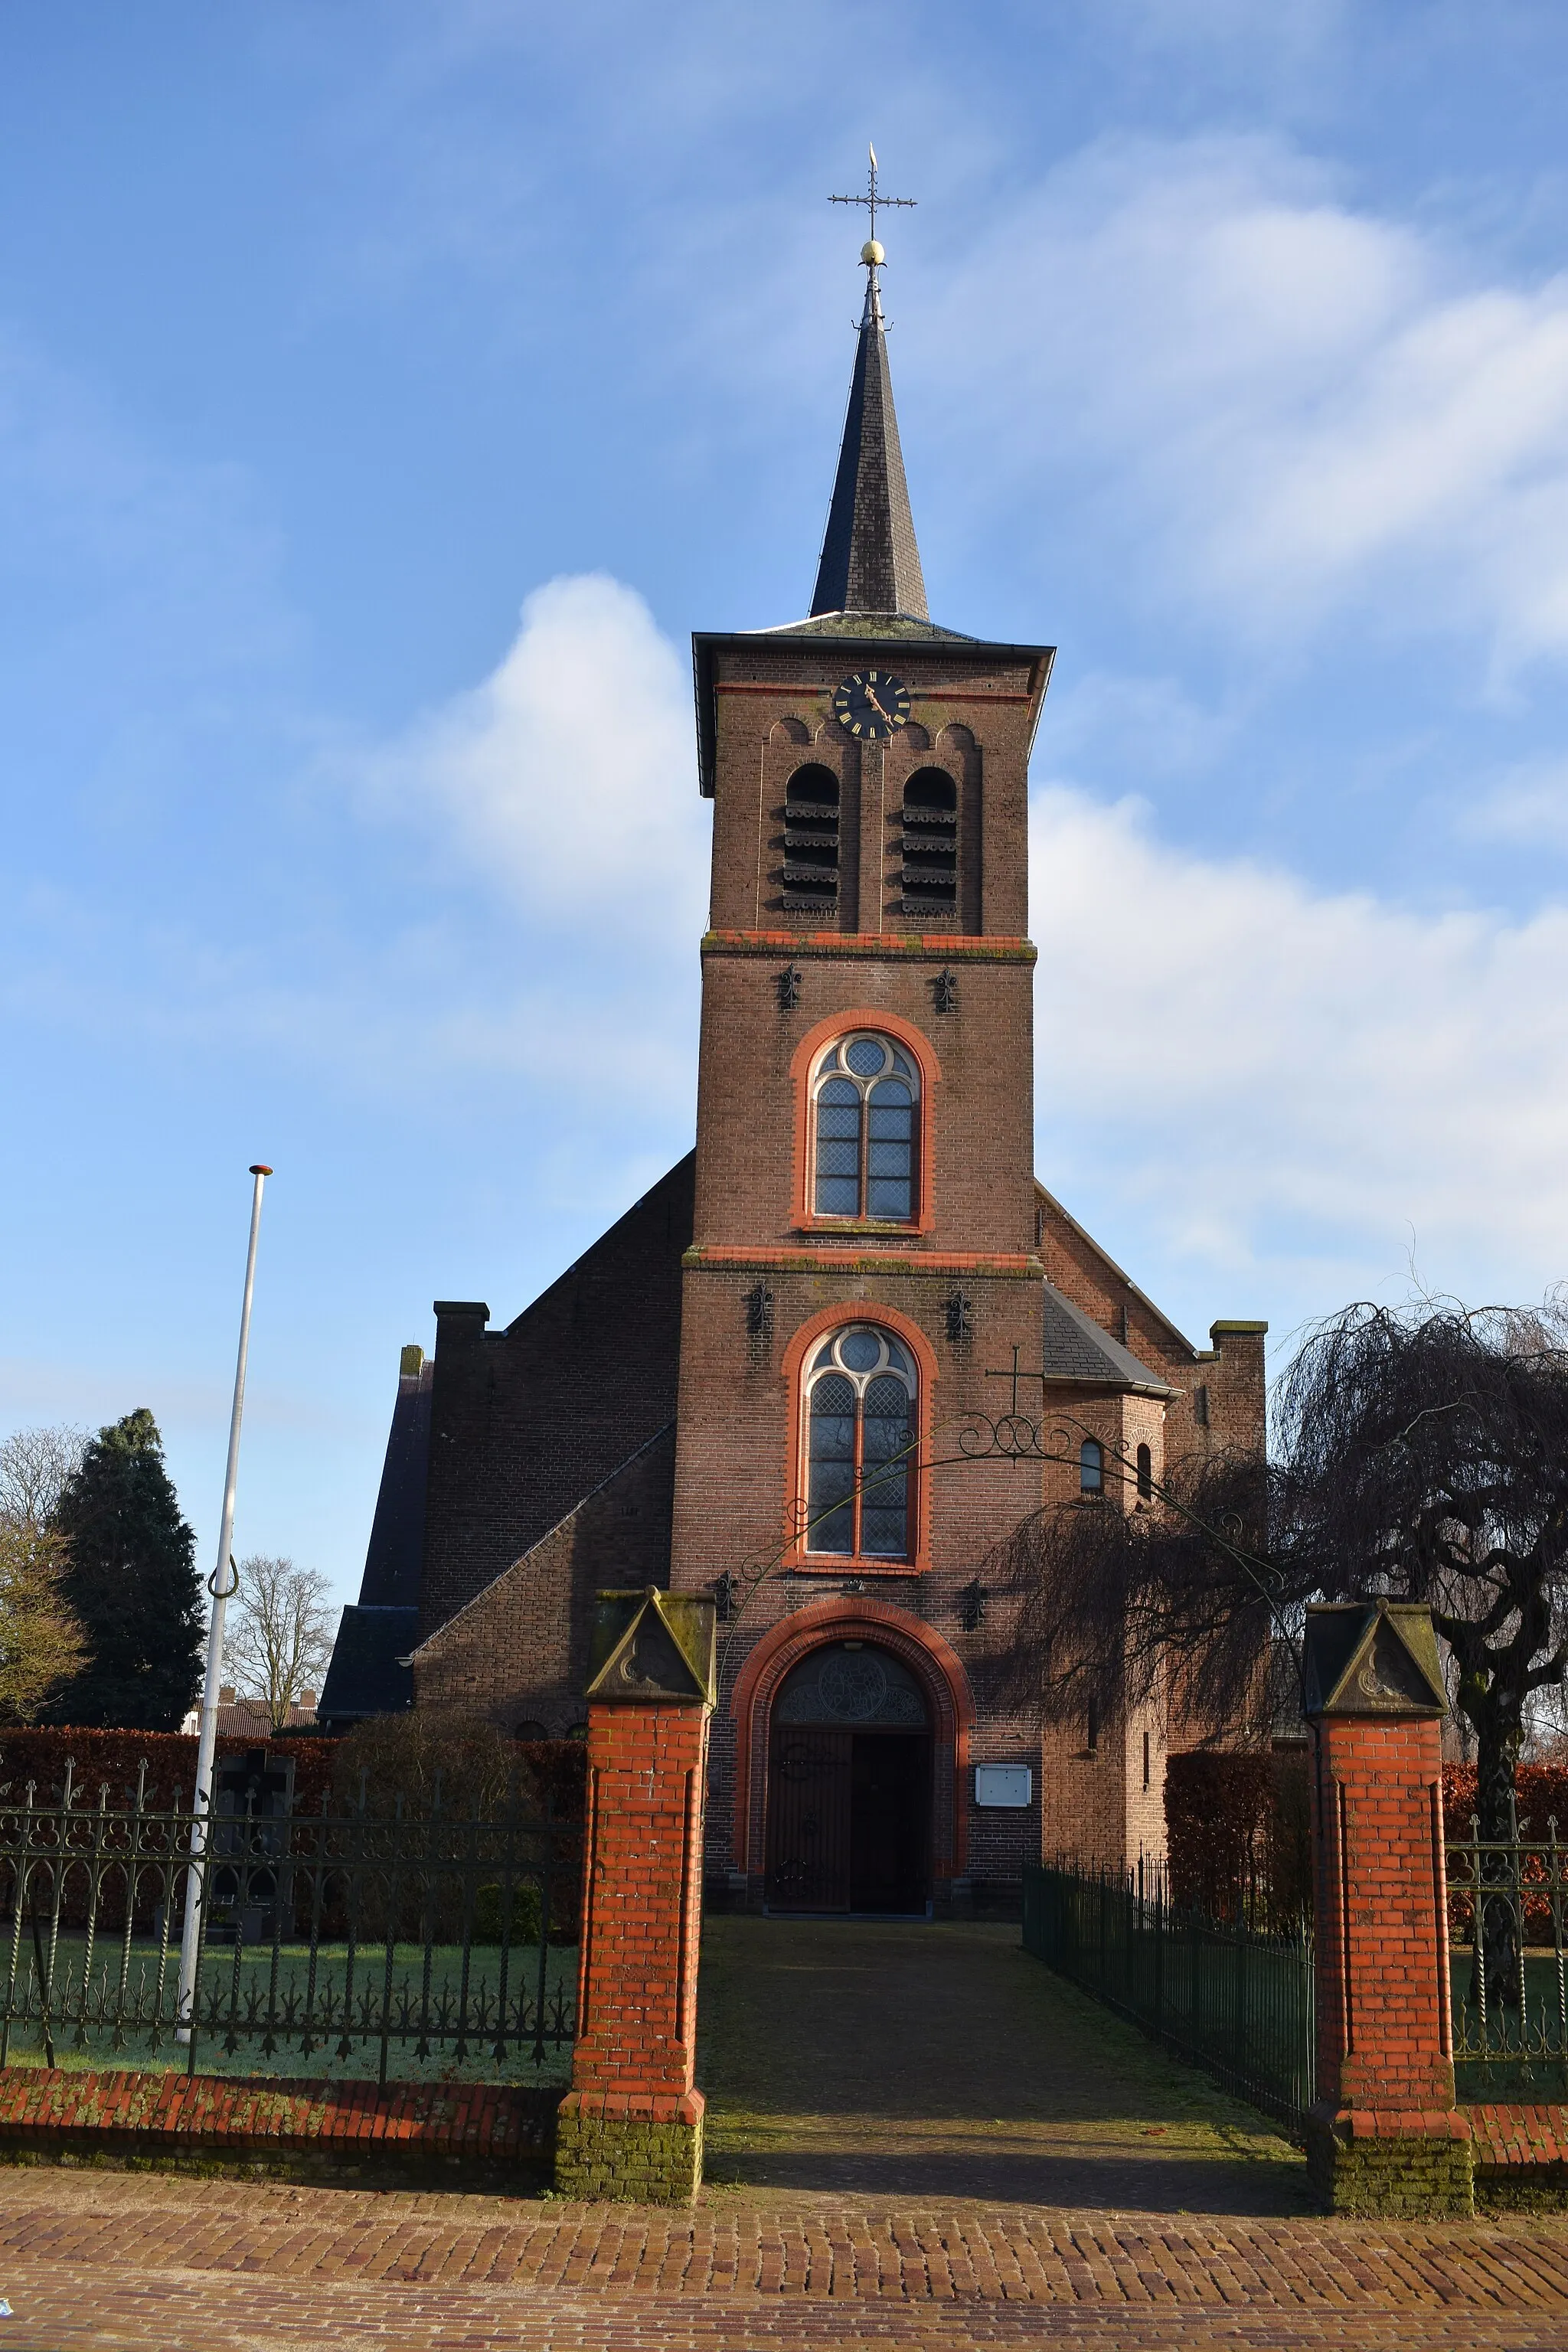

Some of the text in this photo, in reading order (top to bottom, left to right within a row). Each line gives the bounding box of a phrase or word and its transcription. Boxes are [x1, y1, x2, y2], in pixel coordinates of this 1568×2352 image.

[853, 675, 862, 685] XI
[886, 676, 892, 685] I
[851, 723, 862, 734] VII
[870, 727, 876, 738] VI
[885, 724, 892, 734] V
